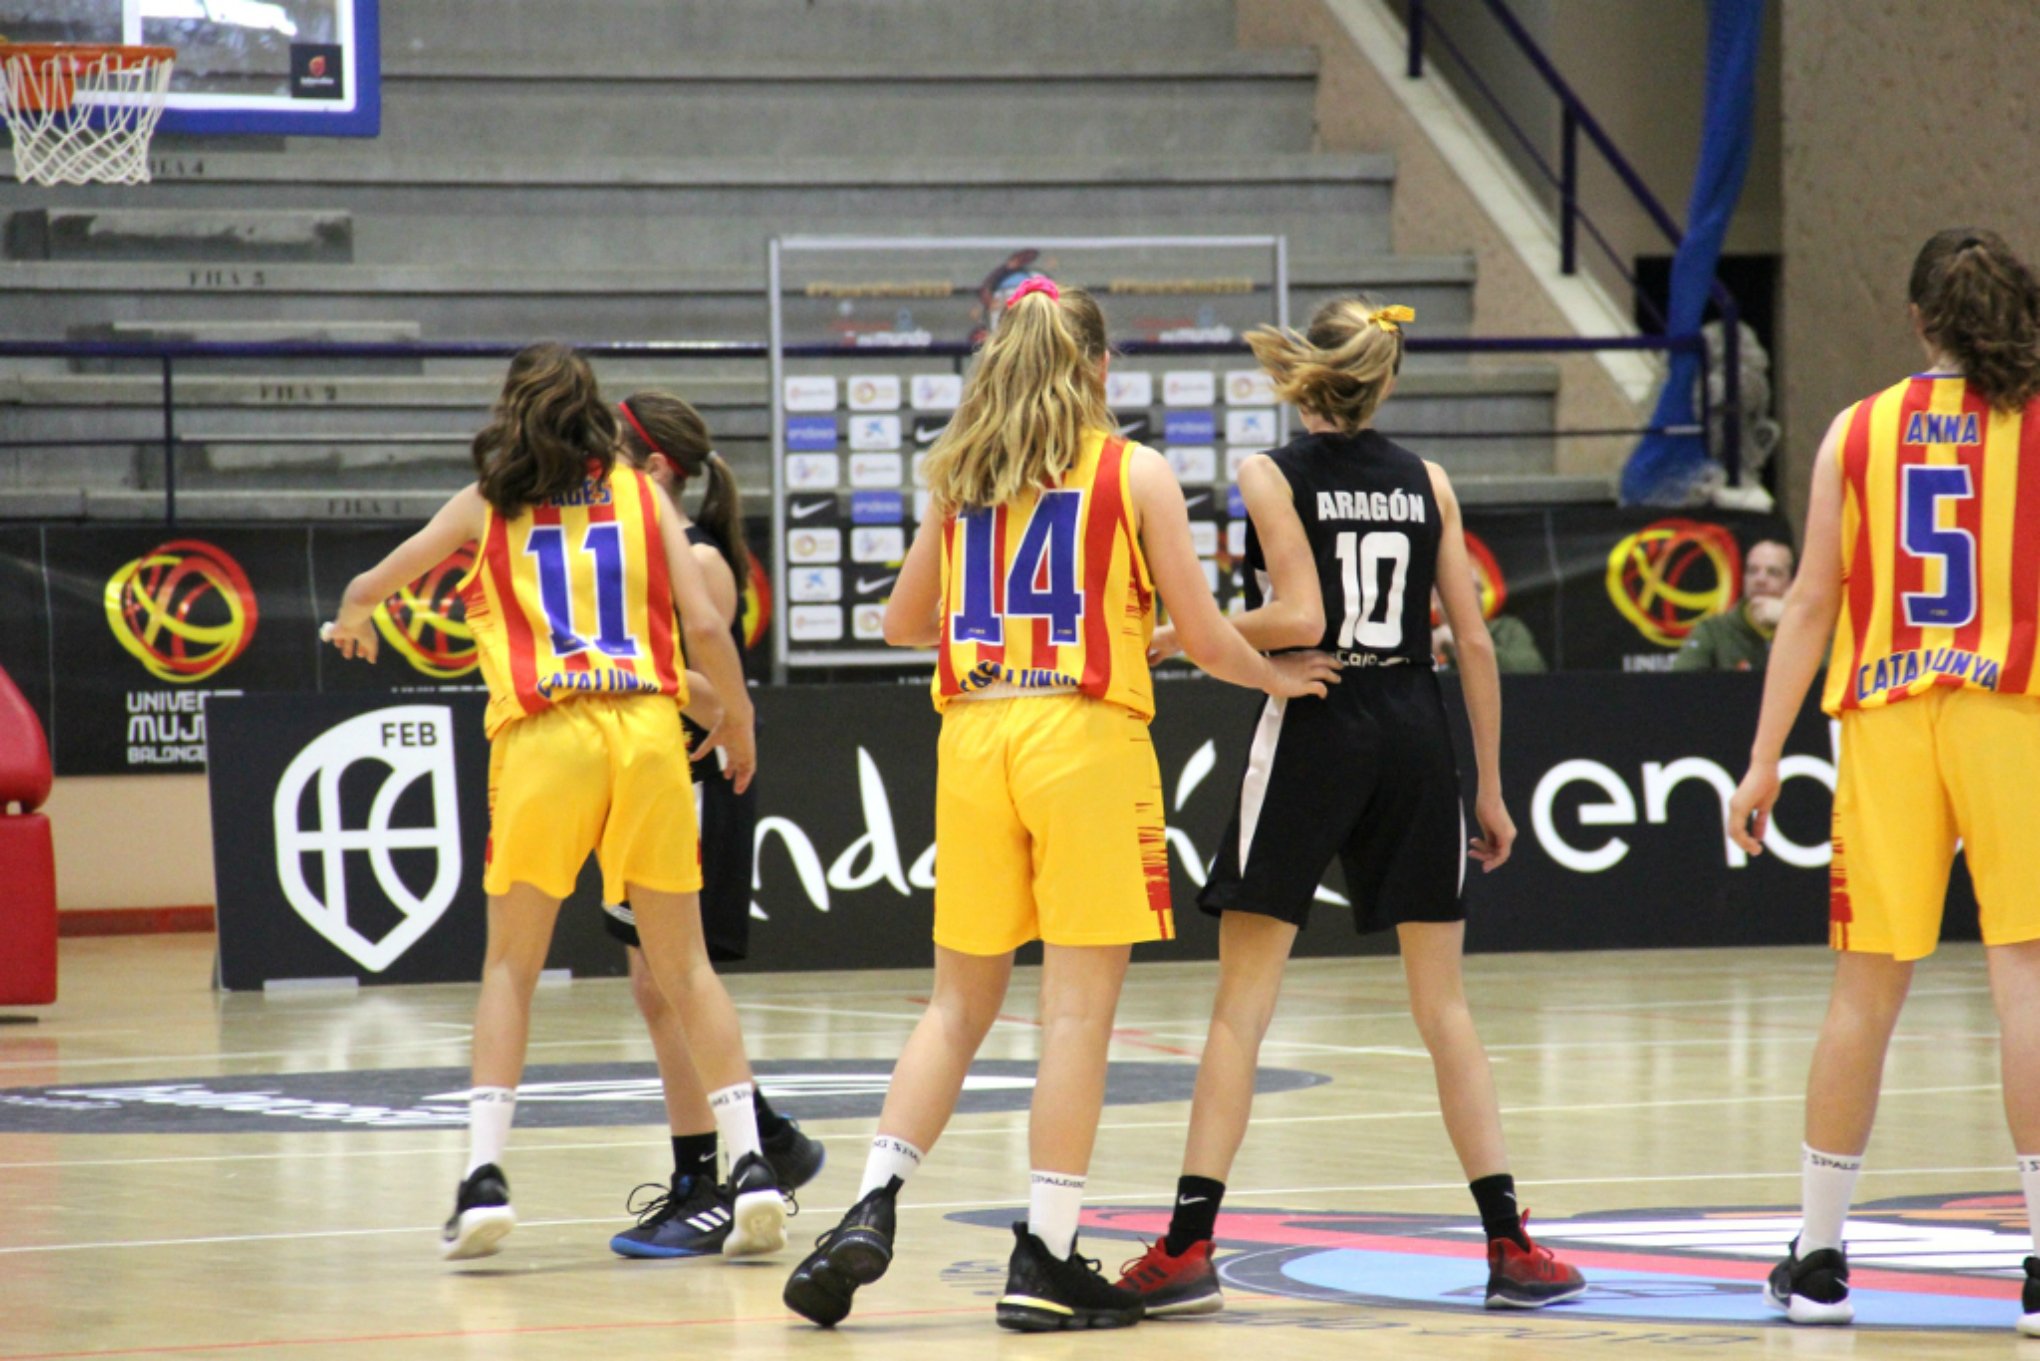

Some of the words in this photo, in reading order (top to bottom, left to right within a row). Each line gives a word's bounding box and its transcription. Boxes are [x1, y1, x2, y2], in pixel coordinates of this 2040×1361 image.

[1904, 411, 1981, 445] ANNA
[1316, 487, 1426, 523] ARAGÓN
[950, 488, 1085, 646] 14
[1901, 463, 1977, 628] 5
[523, 521, 642, 658] 11
[1335, 531, 1410, 649] 10
[127, 714, 206, 743] MUJ
[382, 722, 437, 747] FEB
